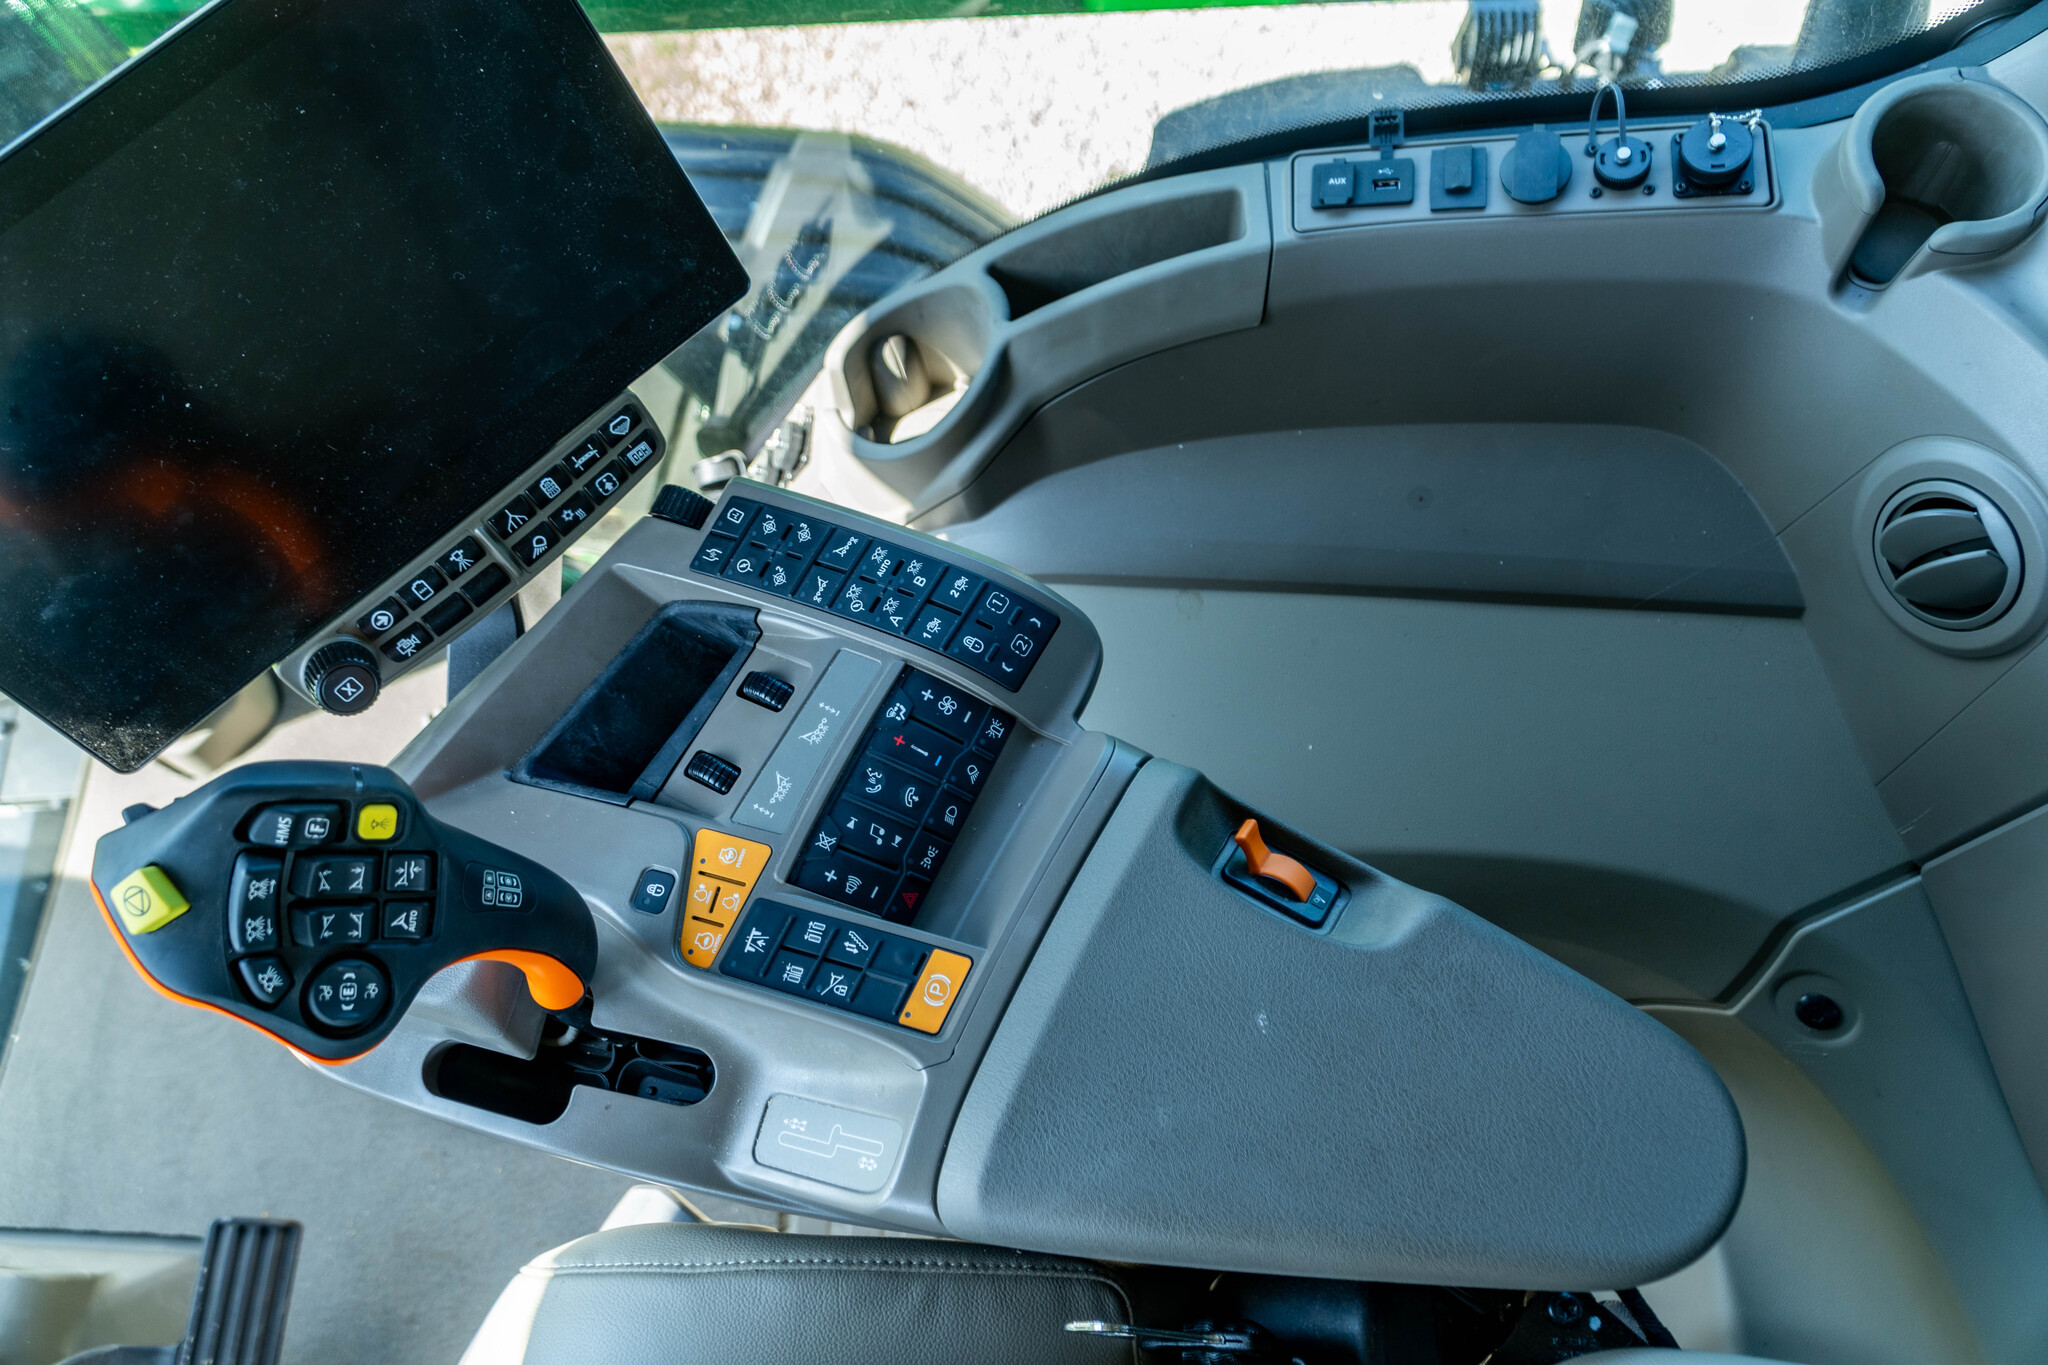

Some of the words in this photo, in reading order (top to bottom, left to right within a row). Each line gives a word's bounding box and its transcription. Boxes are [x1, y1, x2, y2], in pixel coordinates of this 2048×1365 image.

[1328, 177, 1347, 185] AUX
[877, 559, 891, 577] AUTO
[913, 575, 927, 587] B
[949, 589, 960, 598] 2
[889, 615, 903, 627] A
[922, 631, 932, 639] 1
[1015, 640, 1028, 651] 2
[275, 816, 292, 845] HMS
[408, 910, 418, 933] AUTO
[929, 983, 943, 997] P
